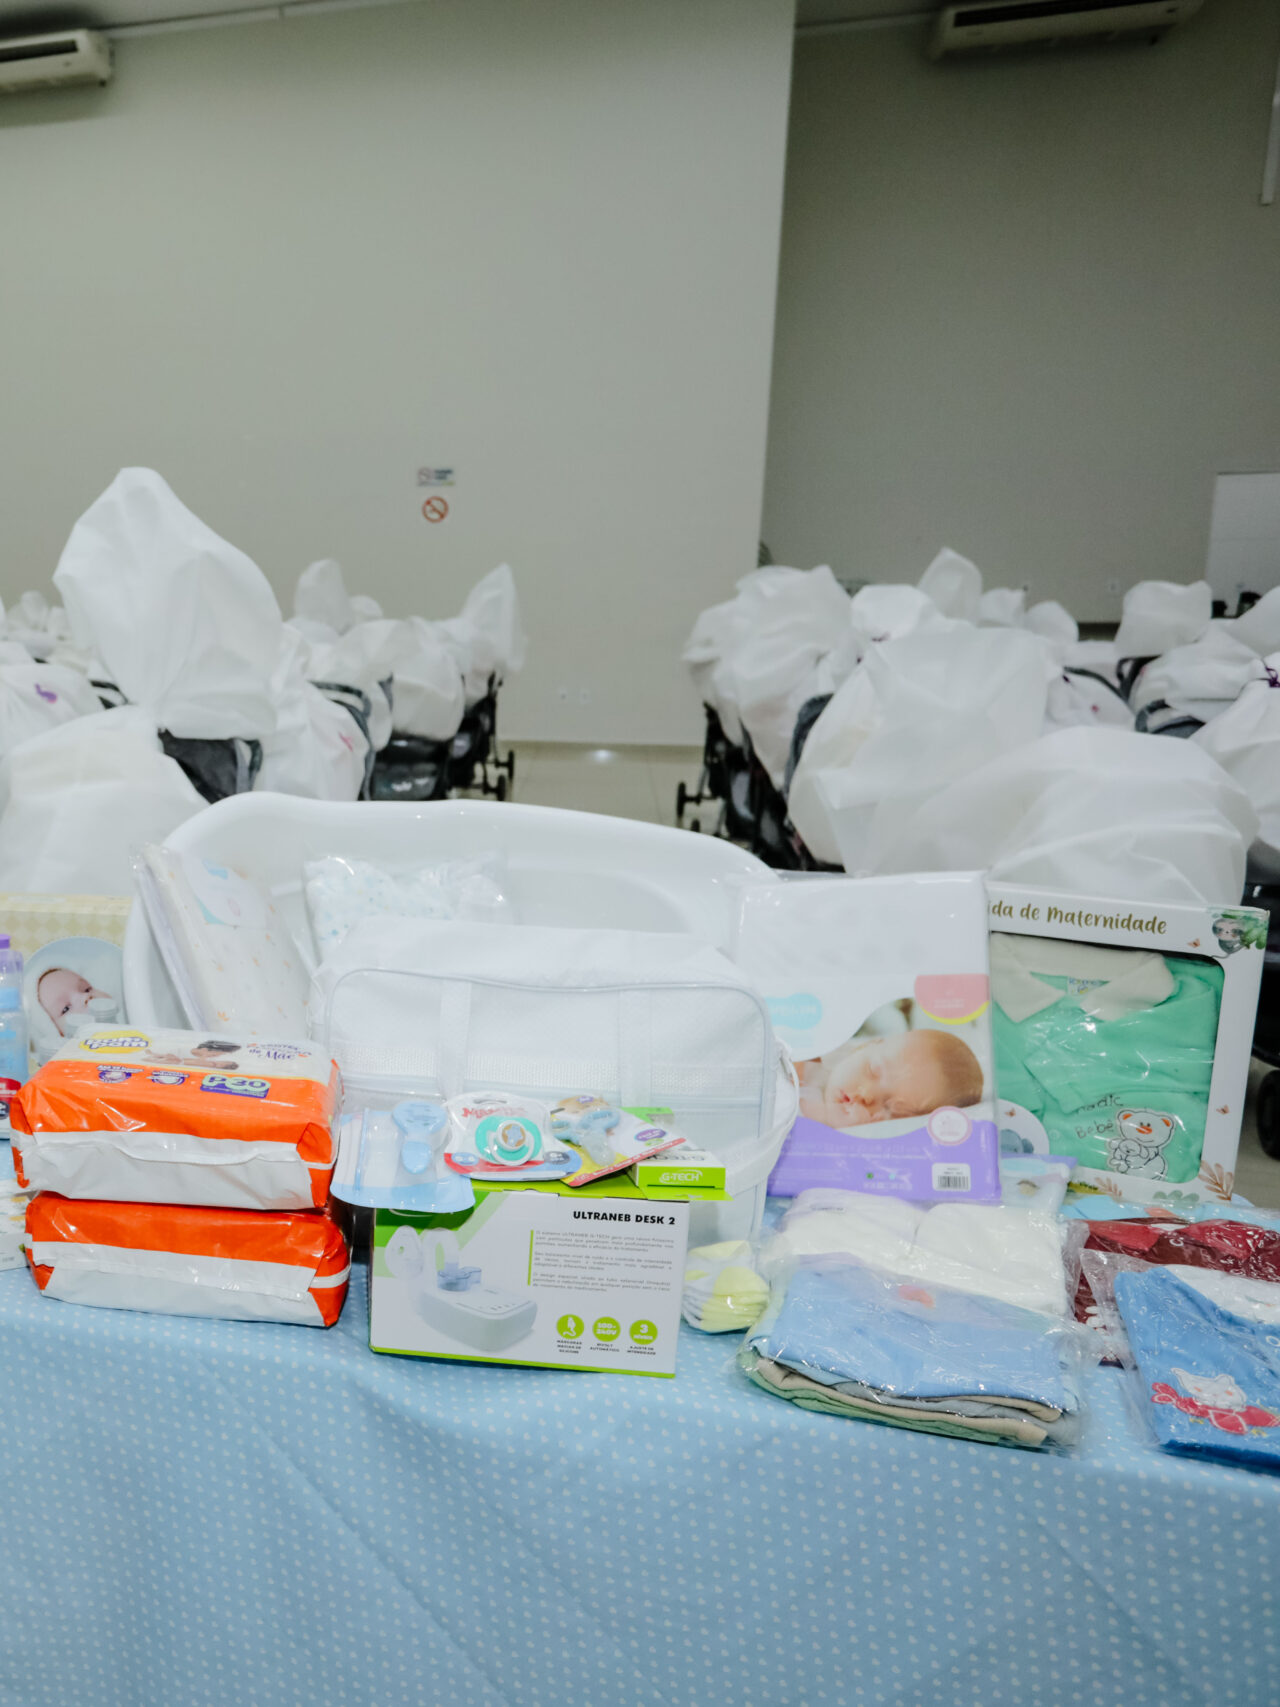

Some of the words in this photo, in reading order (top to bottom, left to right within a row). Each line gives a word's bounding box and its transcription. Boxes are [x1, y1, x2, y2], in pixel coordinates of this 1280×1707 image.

[1020, 903, 1040, 920] de
[1047, 906, 1168, 934] Maternidade
[573, 1211, 631, 1222] ULTRANEB
[635, 1215, 665, 1225] DESK
[669, 1217, 676, 1225] 2
[640, 1324, 648, 1334] 3
